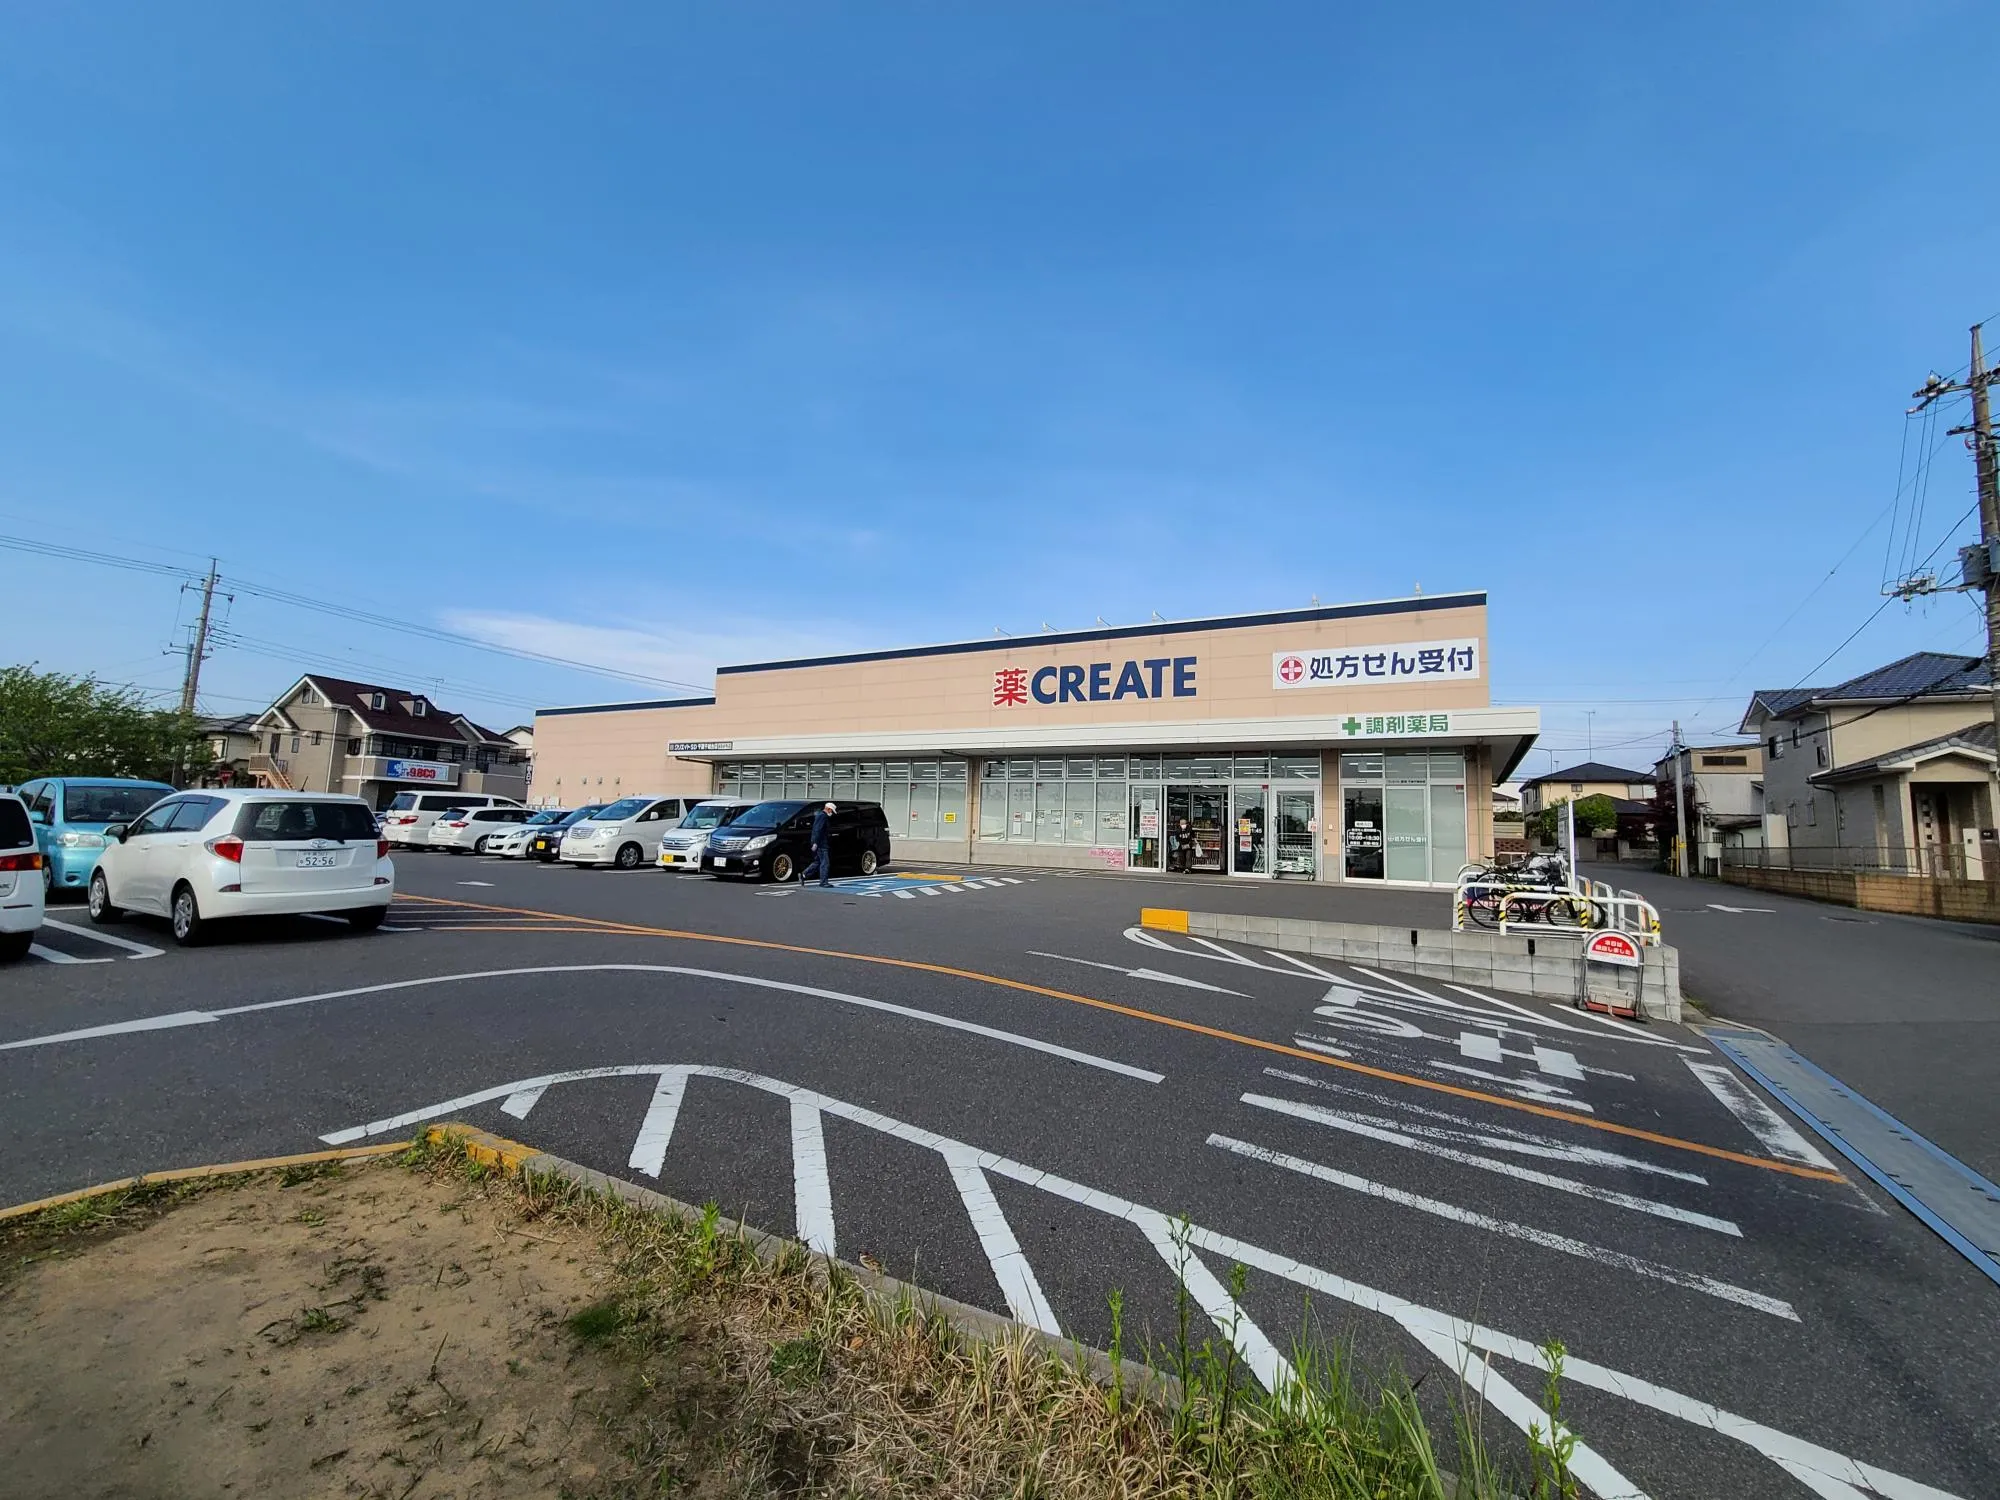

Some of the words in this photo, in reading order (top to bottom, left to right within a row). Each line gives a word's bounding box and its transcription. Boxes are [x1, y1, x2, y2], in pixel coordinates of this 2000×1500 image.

[1310, 646, 1474, 680] 処方せん受付
[993, 669, 1028, 707] 薬
[1031, 656, 1197, 704] CREATE
[1366, 714, 1449, 734] 調剤薬局
